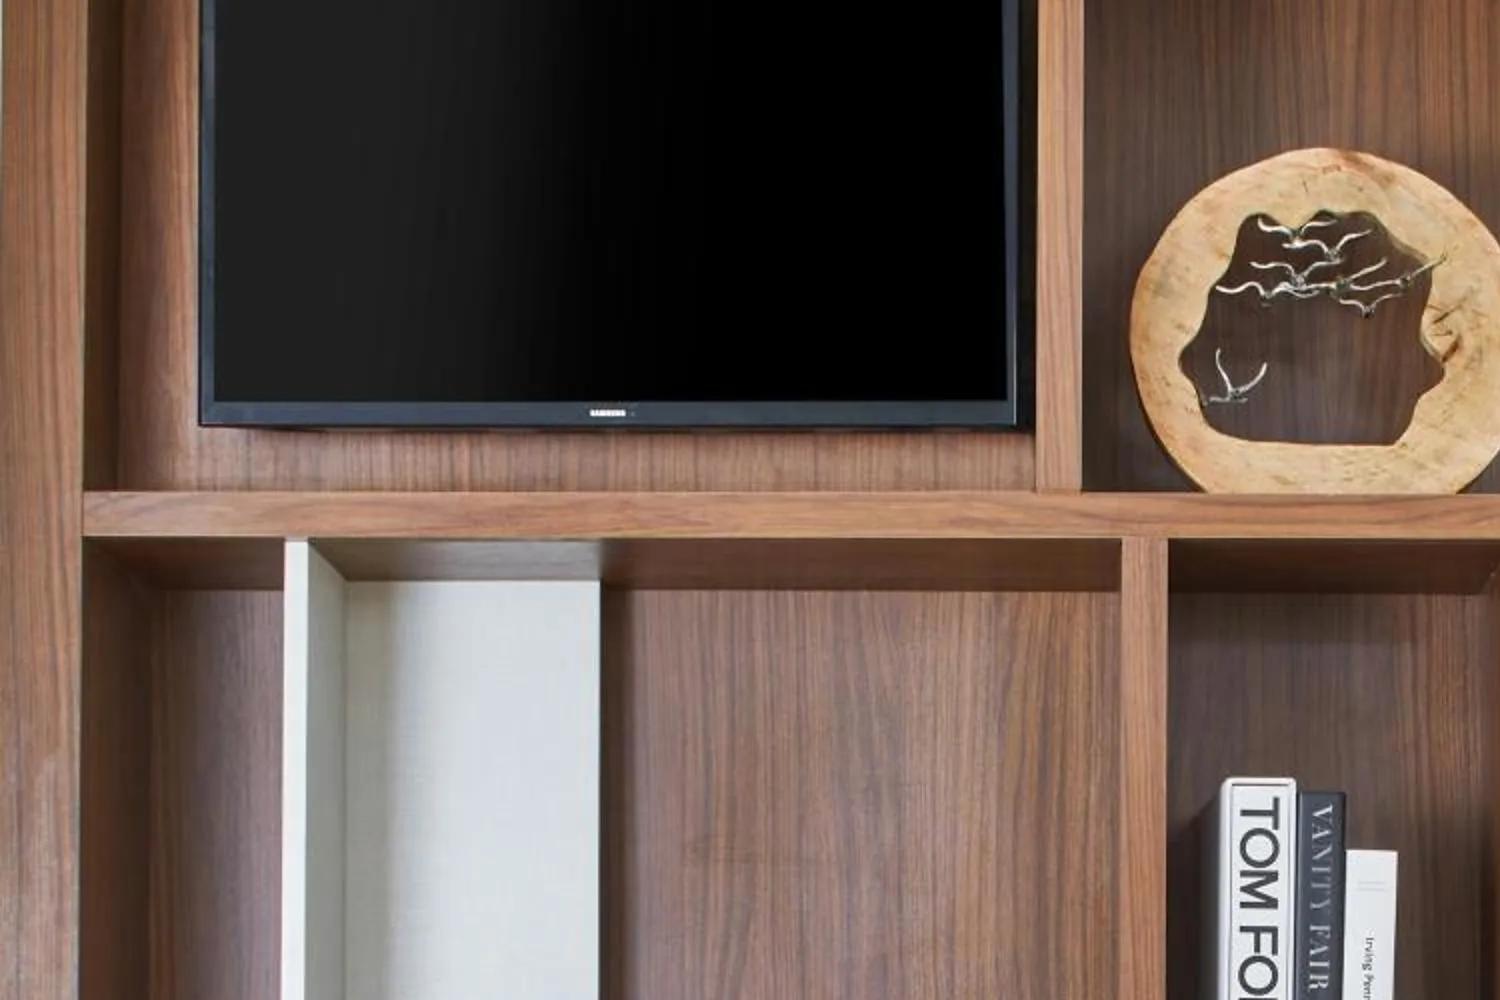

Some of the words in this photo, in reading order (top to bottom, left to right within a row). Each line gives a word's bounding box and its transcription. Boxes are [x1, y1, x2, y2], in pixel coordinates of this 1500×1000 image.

[1239, 796, 1280, 910] TOM
[1309, 803, 1334, 914] VANITY
[1307, 924, 1331, 994] FAIR
[1361, 937, 1375, 972] Irving
